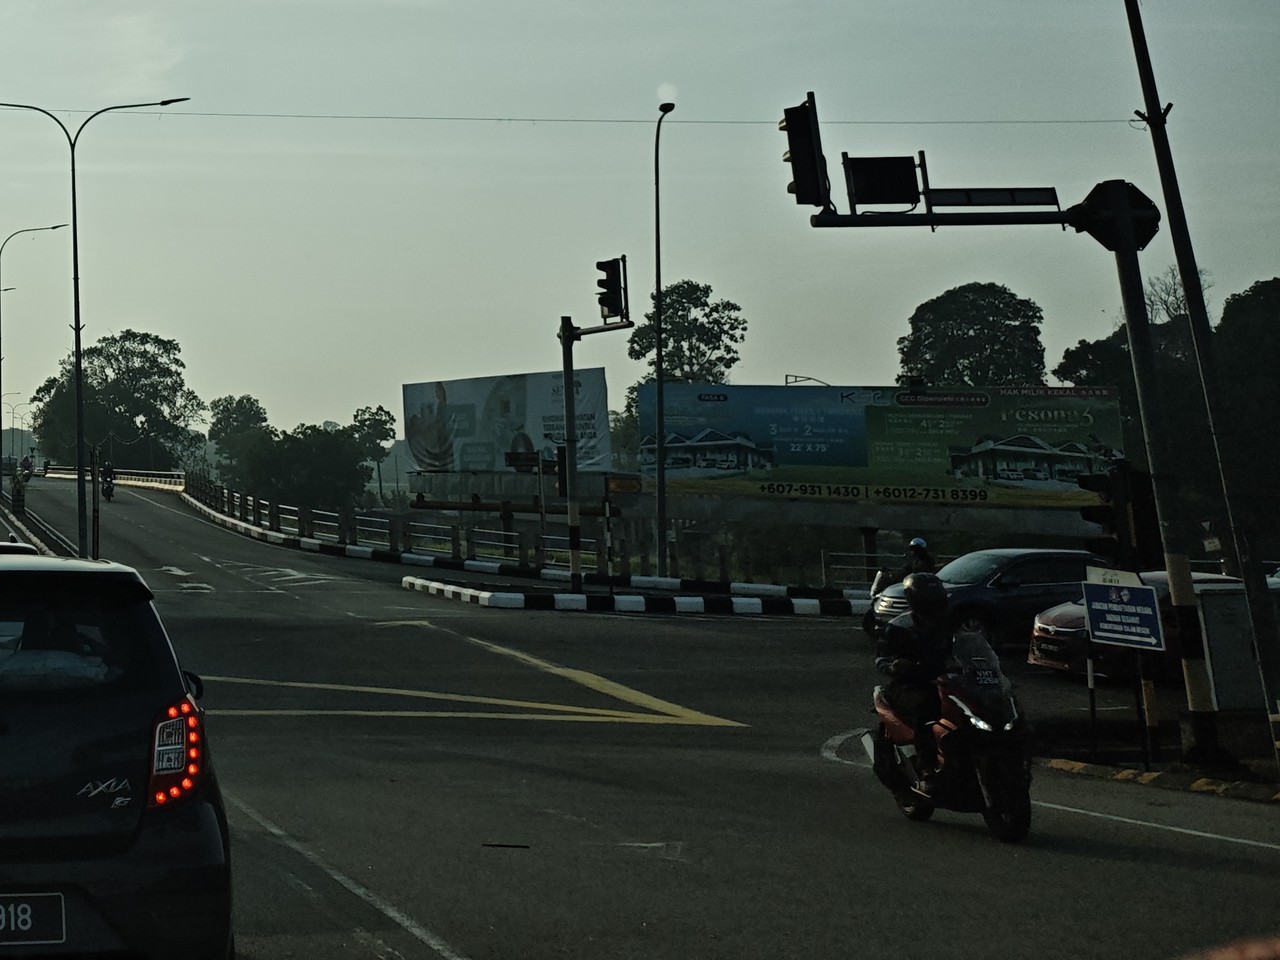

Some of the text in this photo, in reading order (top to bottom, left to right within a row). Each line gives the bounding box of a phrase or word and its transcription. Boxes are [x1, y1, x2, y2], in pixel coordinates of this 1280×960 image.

[1047, 389, 1077, 397] KEKAL
[803, 424, 812, 436] 2
[759, 483, 822, 496] +607-931
[826, 486, 860, 497] 1430
[874, 487, 946, 499] +6012-731
[950, 489, 988, 501] 8399
[76, 776, 132, 798] AXIA
